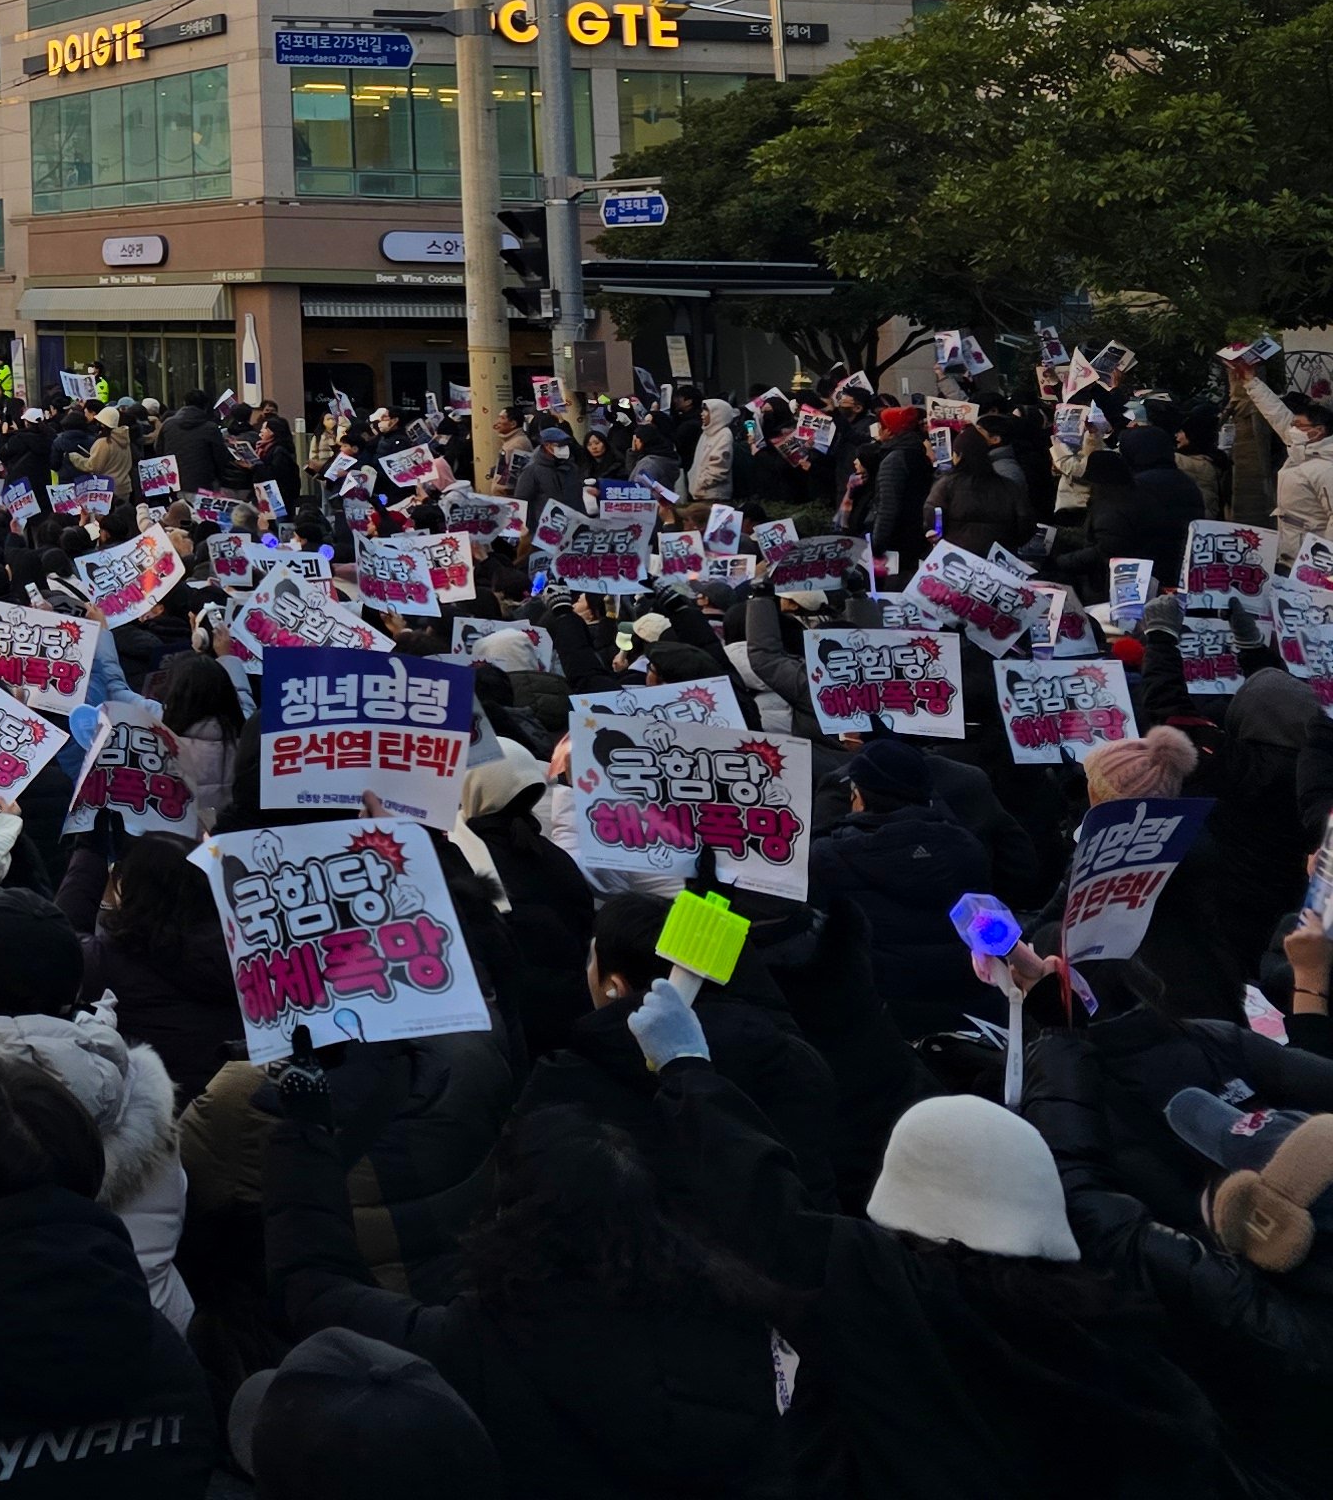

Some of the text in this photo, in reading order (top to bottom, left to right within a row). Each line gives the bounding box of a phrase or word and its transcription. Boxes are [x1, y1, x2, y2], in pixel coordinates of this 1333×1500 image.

[48, 19, 145, 76] DOIGTE
[403, 274, 423, 284] Wine
[569, 529, 634, 556] 국힘당
[784, 542, 847, 566] 국힘당
[1192, 533, 1250, 565] 힘당
[92, 547, 156, 589] 국힘당
[361, 550, 411, 583] 국힘당
[942, 558, 1026, 614] 국힘당
[826, 646, 933, 682] 국힘당
[281, 657, 450, 725] 청년 명령
[817, 678, 957, 717] 해체폭망
[1013, 674, 1102, 715] 국힘당
[96, 722, 170, 772] 힘당
[1010, 705, 1131, 751] 해체폭망
[273, 730, 462, 777] 윤석열 탄핵!
[607, 745, 773, 803] 국힘당
[589, 801, 804, 865] 해체폭망
[233, 849, 394, 948] 국힘당
[236, 913, 453, 1029] 해체폭망
